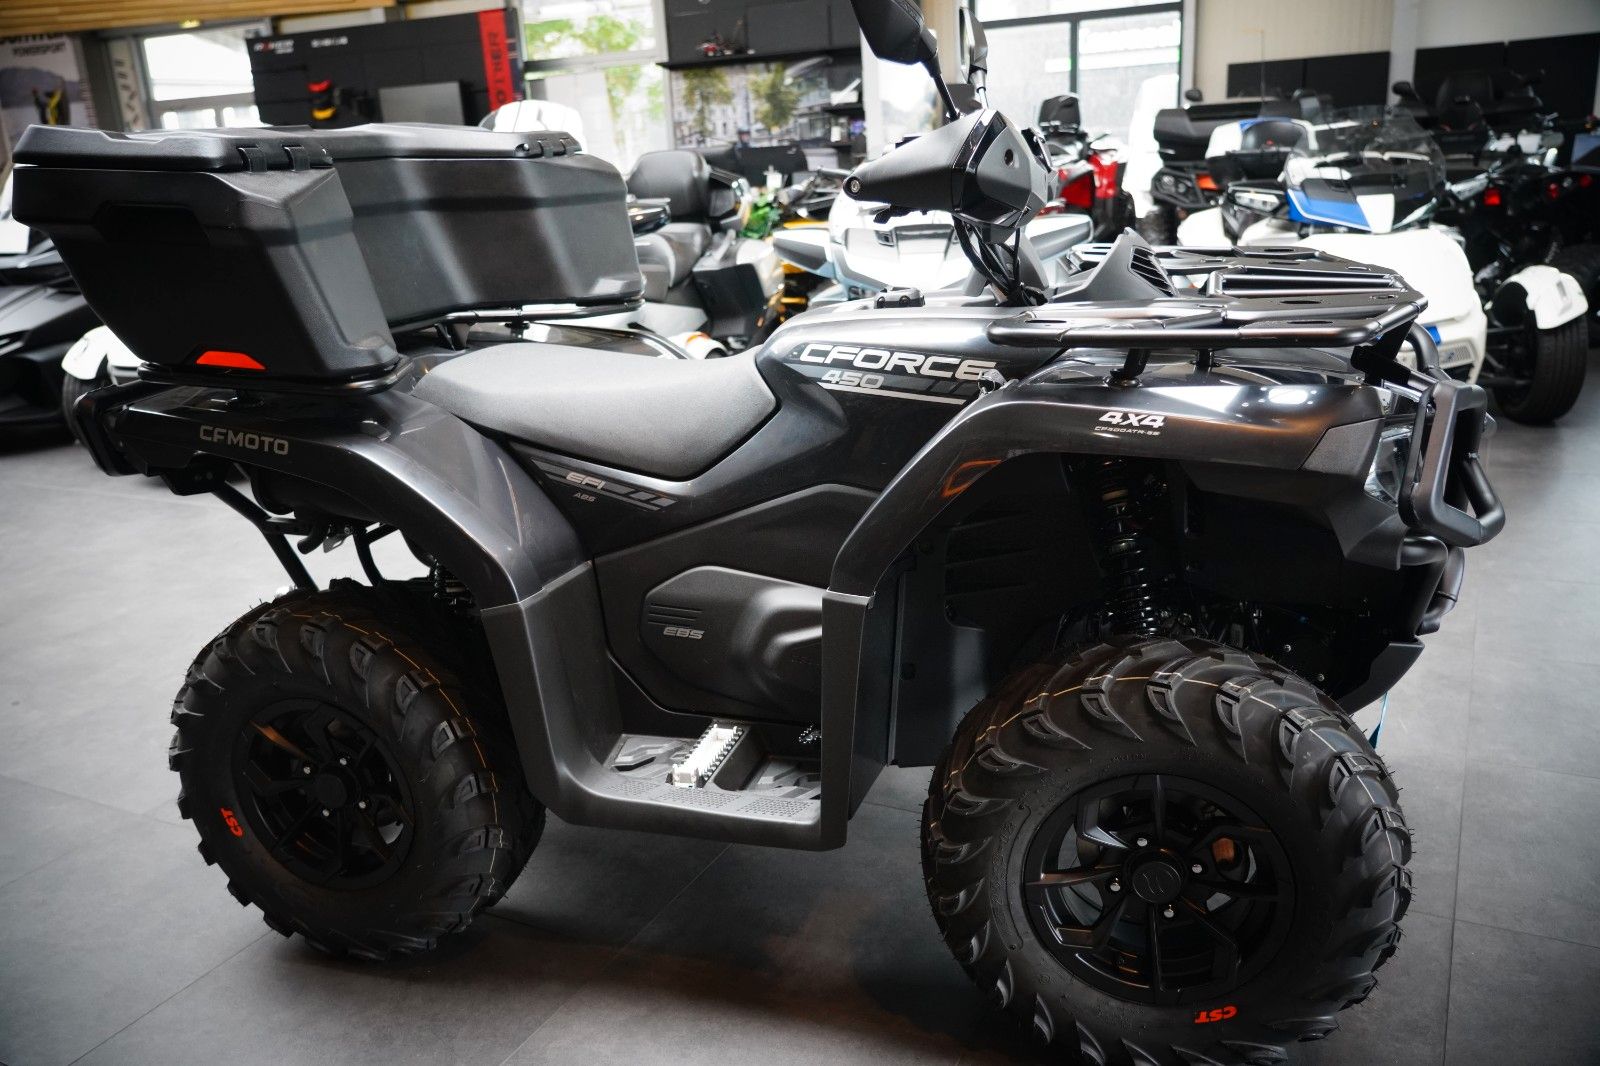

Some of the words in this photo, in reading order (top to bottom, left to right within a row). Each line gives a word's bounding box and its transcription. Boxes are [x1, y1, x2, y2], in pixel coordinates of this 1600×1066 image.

[800, 344, 997, 381] CFORCE
[820, 370, 885, 388] 450
[1098, 411, 1166, 429] 4X4
[200, 425, 289, 455] CFMOTO
[566, 472, 606, 490] EFI
[663, 626, 705, 640] EBS
[220, 807, 243, 837] CST
[1194, 1005, 1237, 1023] CST
